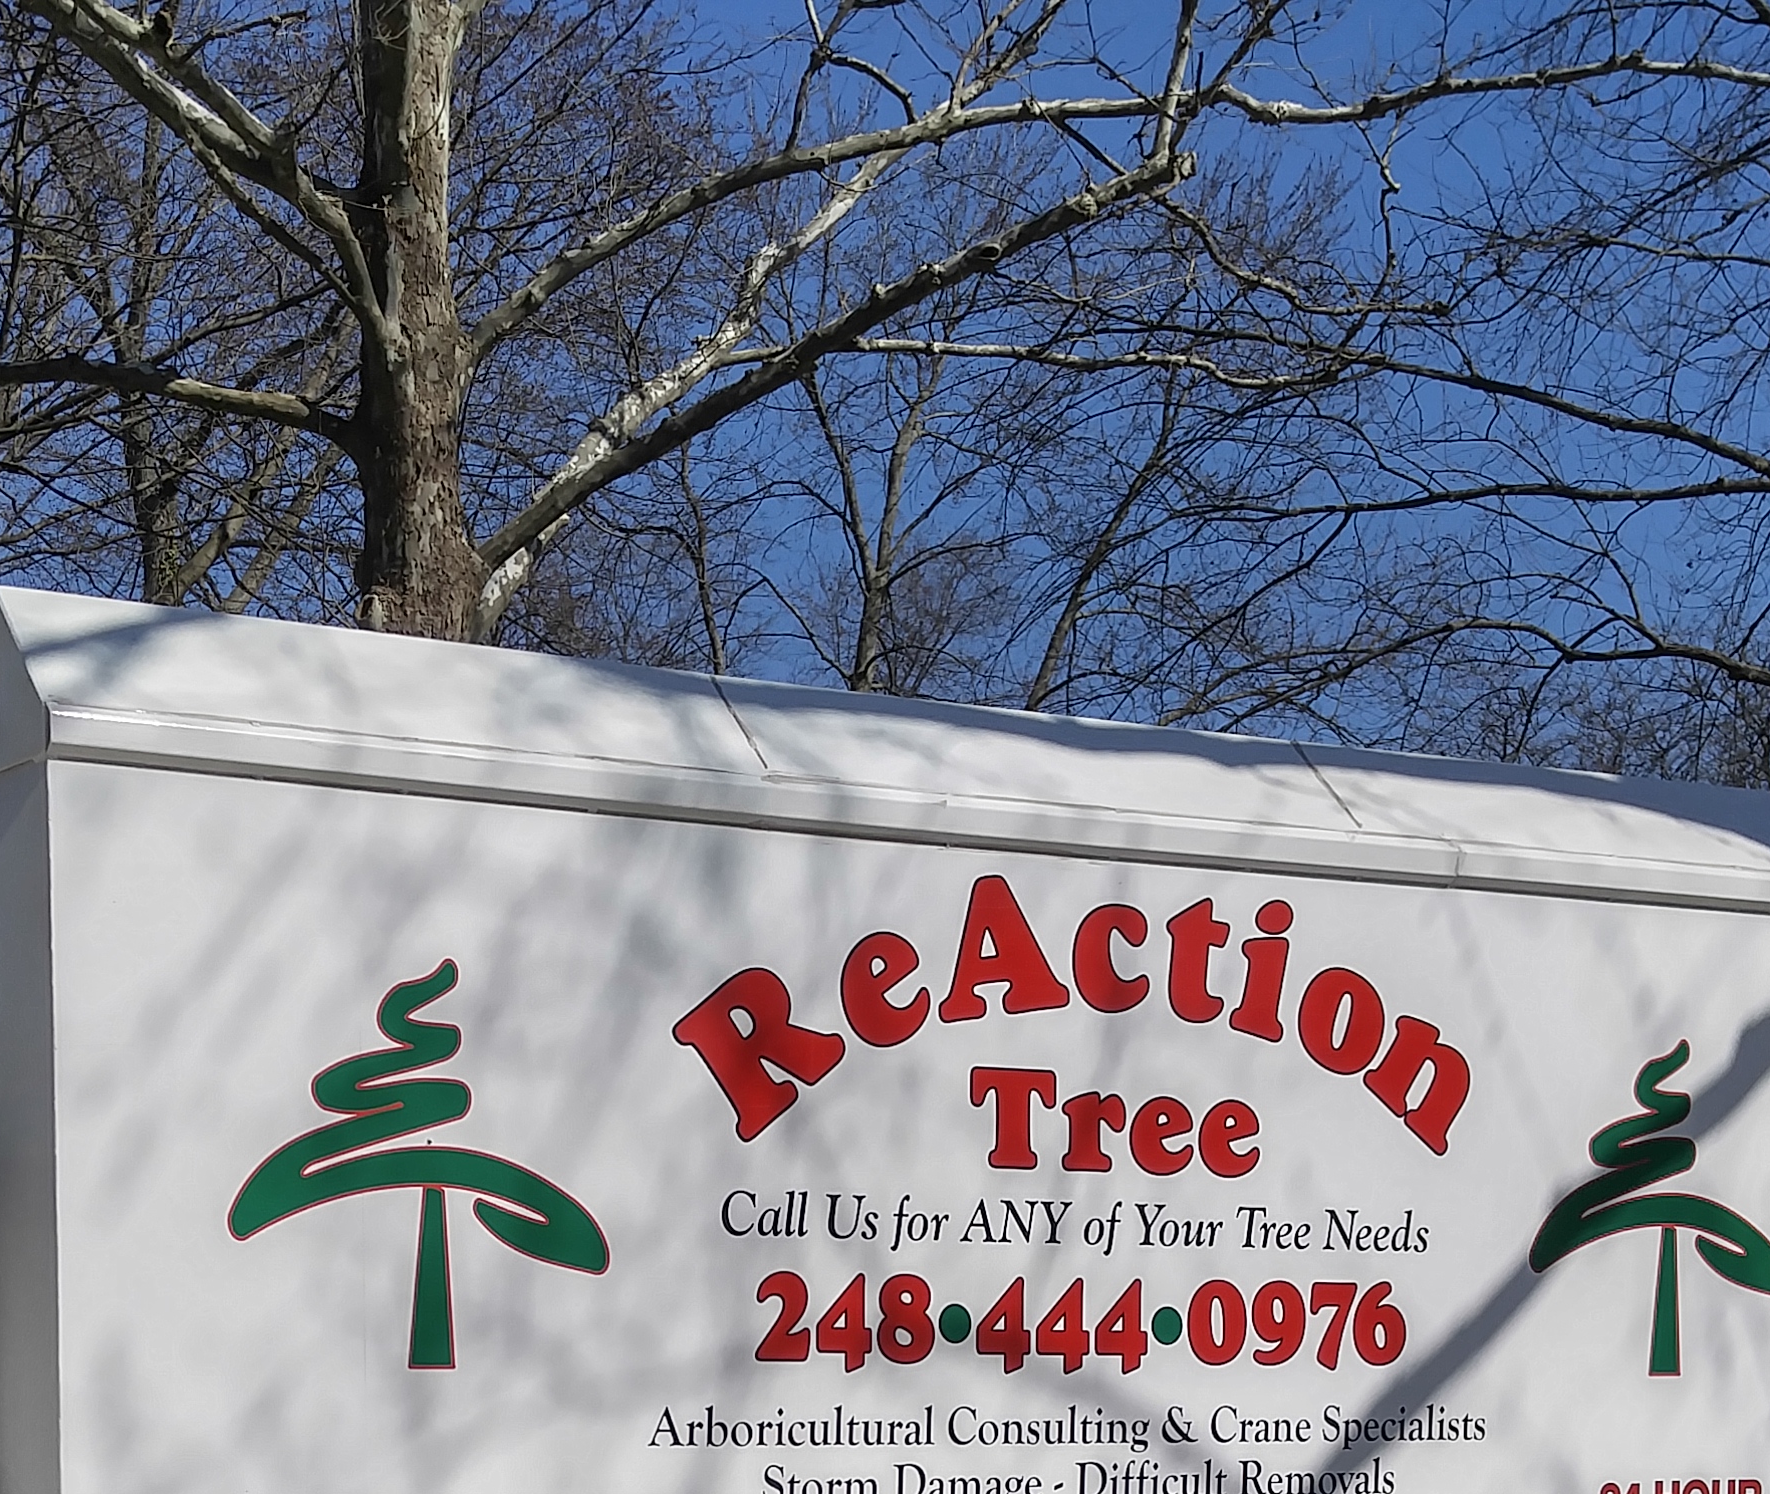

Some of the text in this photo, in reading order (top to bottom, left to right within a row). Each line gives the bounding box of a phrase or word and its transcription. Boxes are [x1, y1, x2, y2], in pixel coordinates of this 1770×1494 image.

[673, 875, 1470, 1156] ReAction
[970, 1066, 1260, 1178] Tree
[722, 1191, 1429, 1256] Call Us for ANY of Your Tree Needs
[648, 1405, 1487, 1452] Arboricultural Consulting & Crane Specialists
